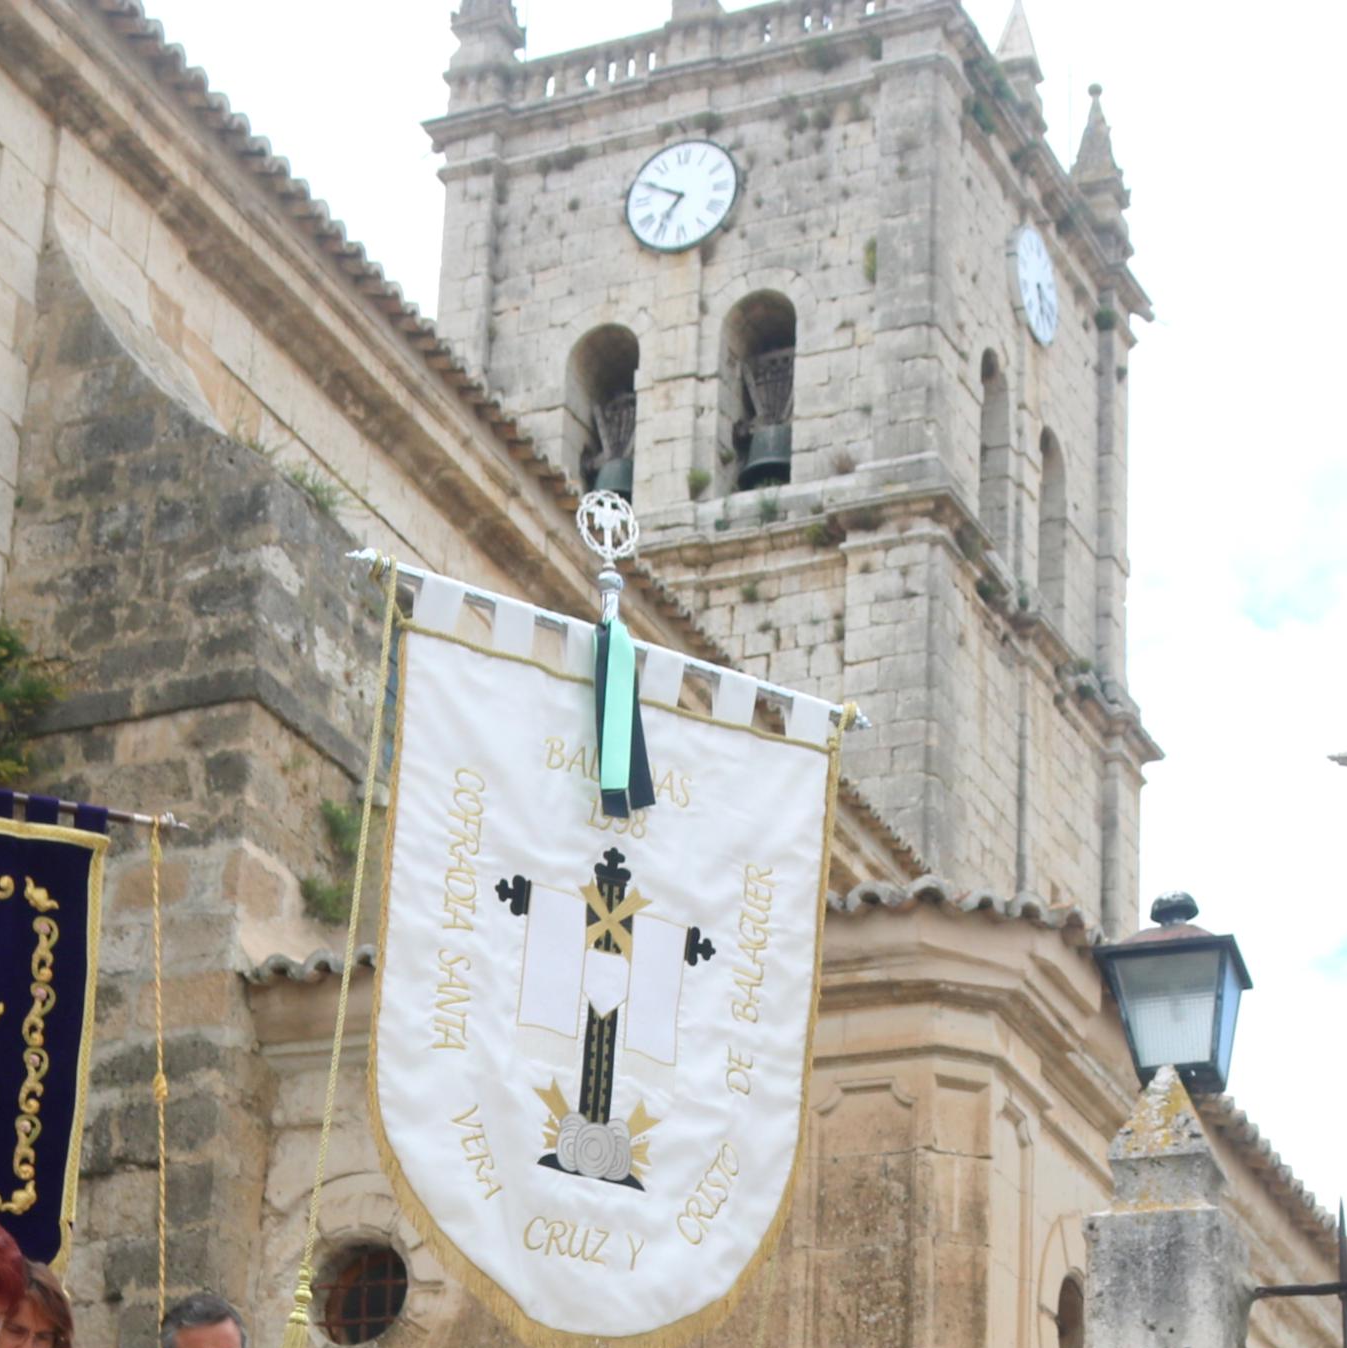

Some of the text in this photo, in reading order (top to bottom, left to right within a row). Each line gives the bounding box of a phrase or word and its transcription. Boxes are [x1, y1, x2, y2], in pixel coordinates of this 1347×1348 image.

[544, 736, 693, 809] BALAS
[432, 767, 777, 1271] COFRADIA SANTA VERA CRUZ Y CRISTO DE BALAGUER
